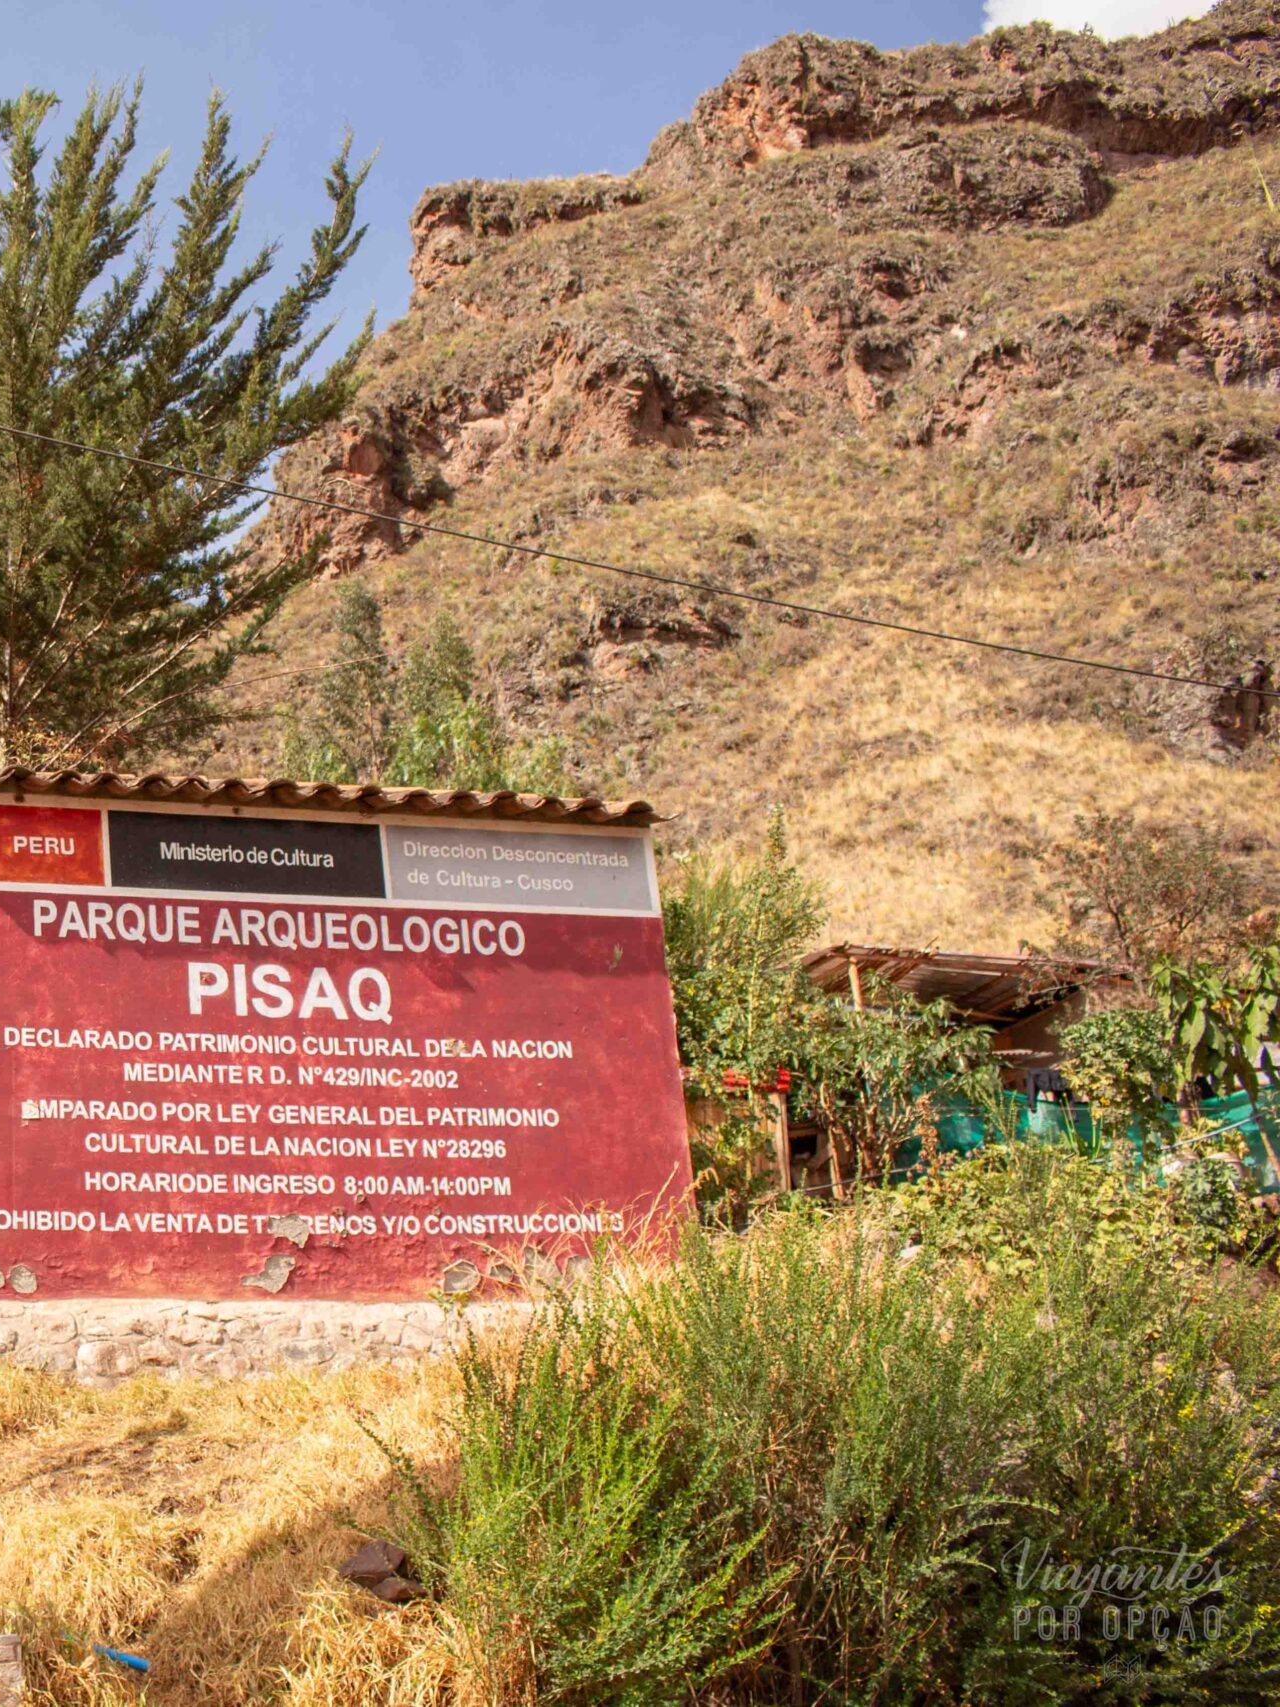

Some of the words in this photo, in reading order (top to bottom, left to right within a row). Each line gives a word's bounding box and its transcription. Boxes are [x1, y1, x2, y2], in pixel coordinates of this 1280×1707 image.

[13, 836, 75, 856] PERU
[160, 841, 244, 863] Ministerio
[246, 847, 268, 865] de
[271, 847, 335, 868] Cultura
[403, 840, 488, 861] Direccion
[492, 845, 629, 868] Desconcentrada
[407, 869, 429, 885] de
[437, 870, 501, 889] Cultura
[517, 874, 574, 892] Cusco
[33, 899, 202, 945] PARQUE
[211, 908, 526, 957] ARQUEOLOGICO
[187, 962, 393, 1025] PISAQ
[3, 1027, 153, 1051] DECLARADO
[159, 1031, 296, 1055] PATRIMONIO
[302, 1036, 420, 1058] CULTURAL
[491, 1039, 574, 1060] NACION
[124, 1062, 244, 1084] MEDIANTE
[162, 1103, 211, 1123] POR
[217, 1103, 261, 1124] LEY
[268, 1104, 376, 1127] GENERAL
[380, 1107, 424, 1127] DEL
[427, 1107, 560, 1128] PATRIMONIO
[84, 1132, 209, 1156] CULTURAL
[214, 1135, 245, 1156] DE
[250, 1136, 281, 1157] LA
[284, 1137, 372, 1159] NACION
[377, 1138, 418, 1159] LEY
[233, 1174, 335, 1195] INGRESO
[343, 1175, 389, 1196] 8:00
[100, 1211, 131, 1233] LA
[133, 1212, 213, 1234] VENTA
[217, 1213, 249, 1234] DE
[252, 1214, 377, 1236] TRENOS
[381, 1215, 421, 1236] Y/O
